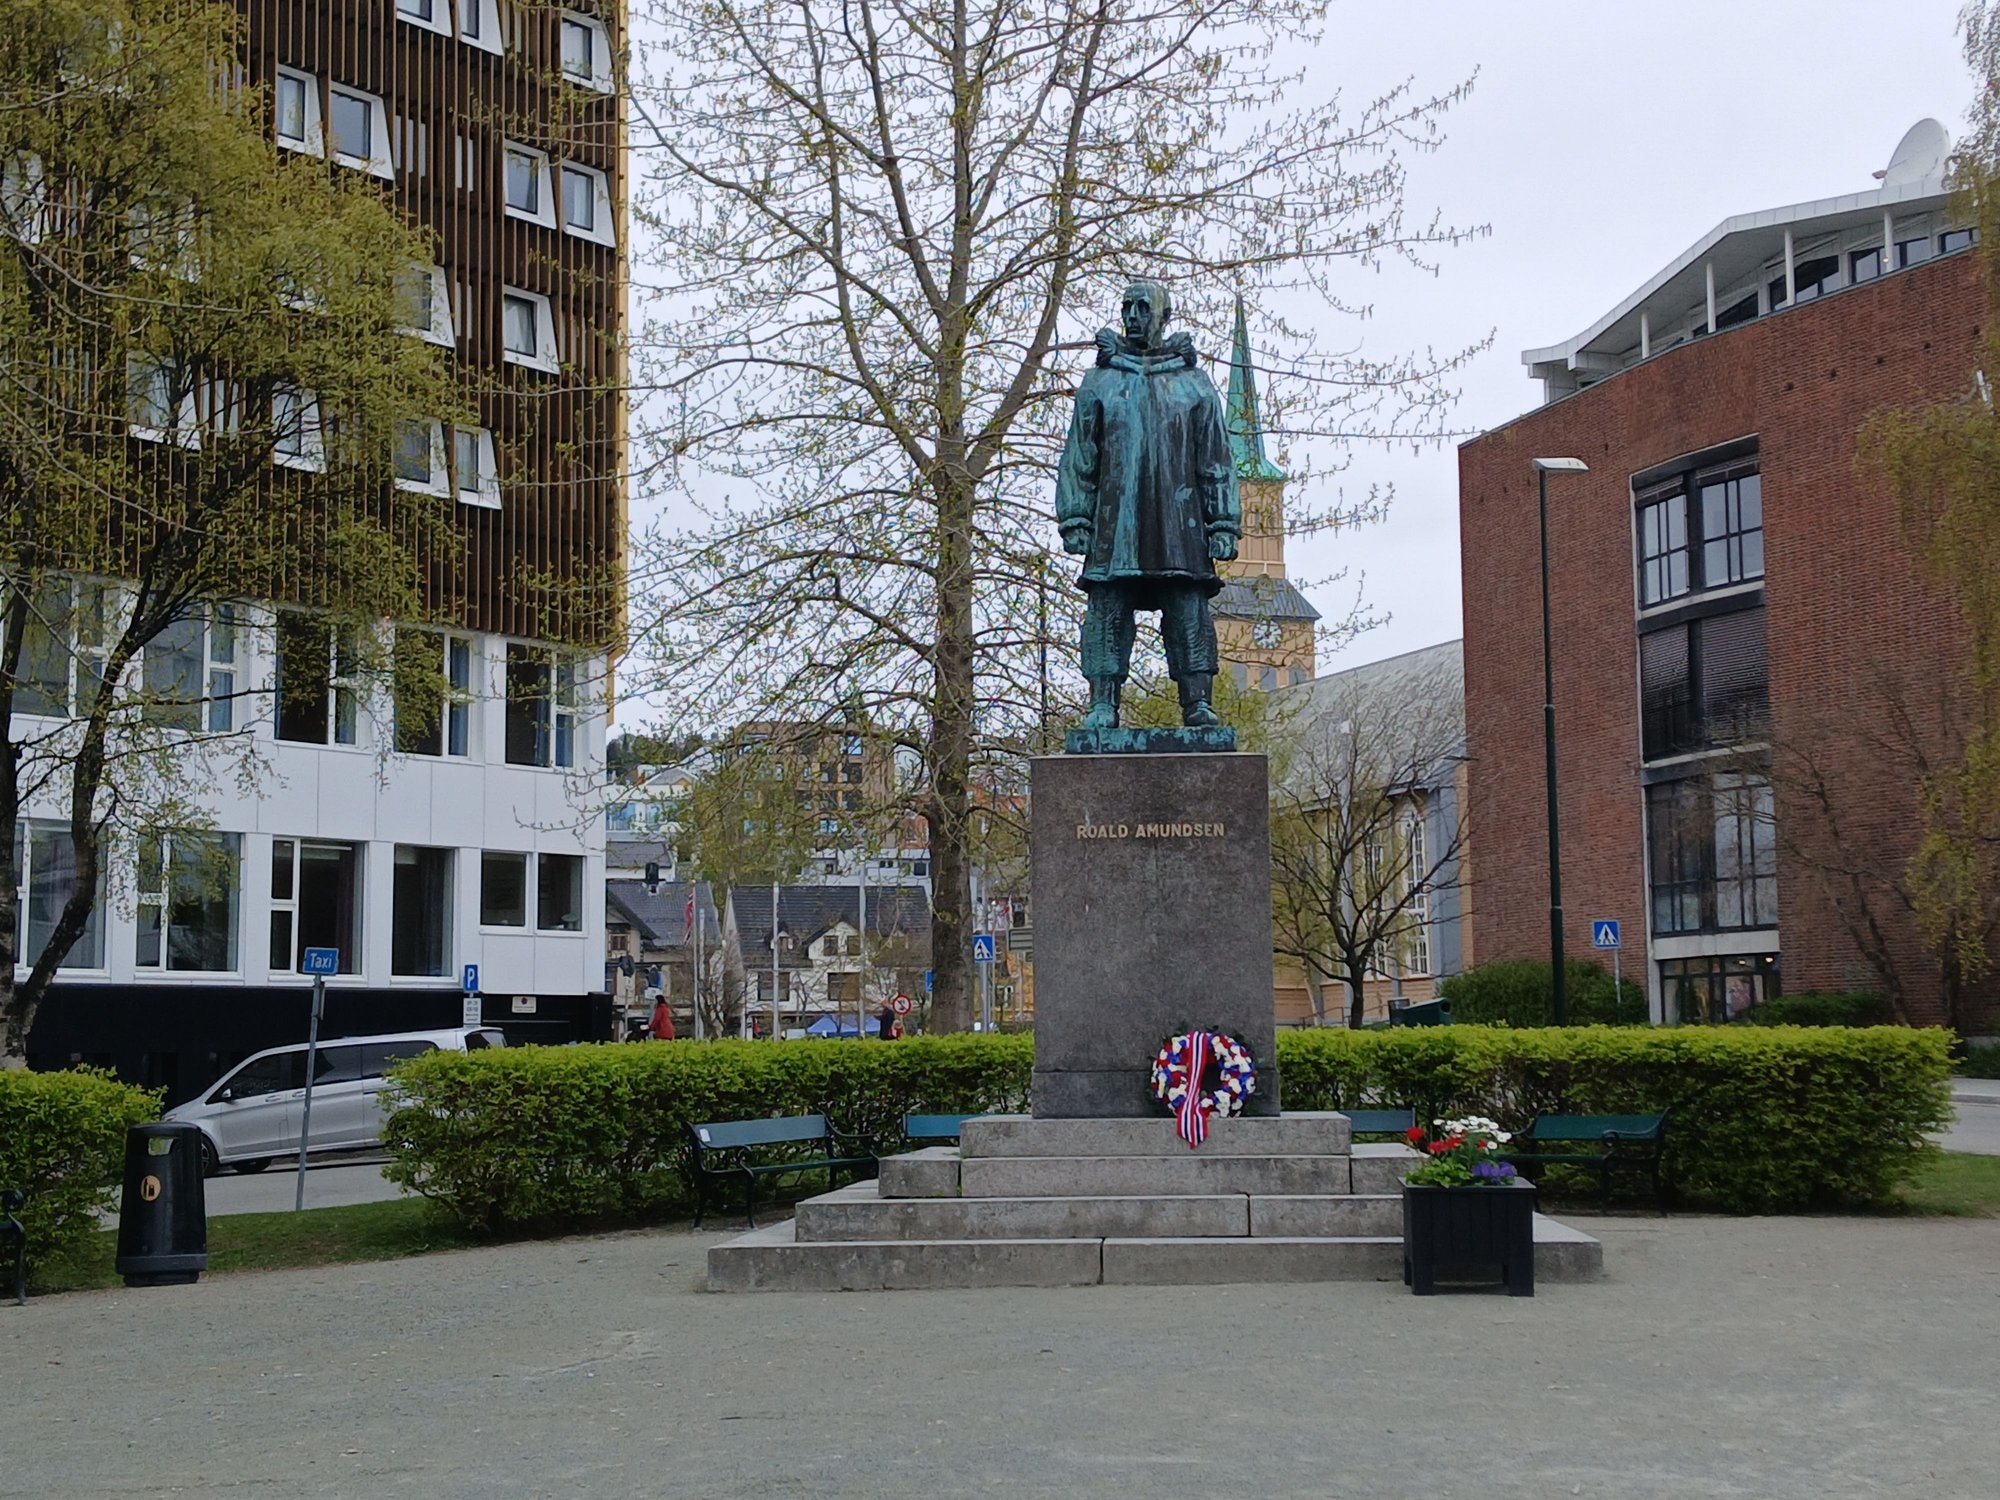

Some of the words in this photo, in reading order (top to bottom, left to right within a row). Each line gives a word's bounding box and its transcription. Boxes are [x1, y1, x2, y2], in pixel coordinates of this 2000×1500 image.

[1076, 824, 1129, 839] ROALD
[1135, 823, 1225, 839] AMUNDSEN
[310, 952, 332, 969] Taxi
[467, 967, 475, 989] P
